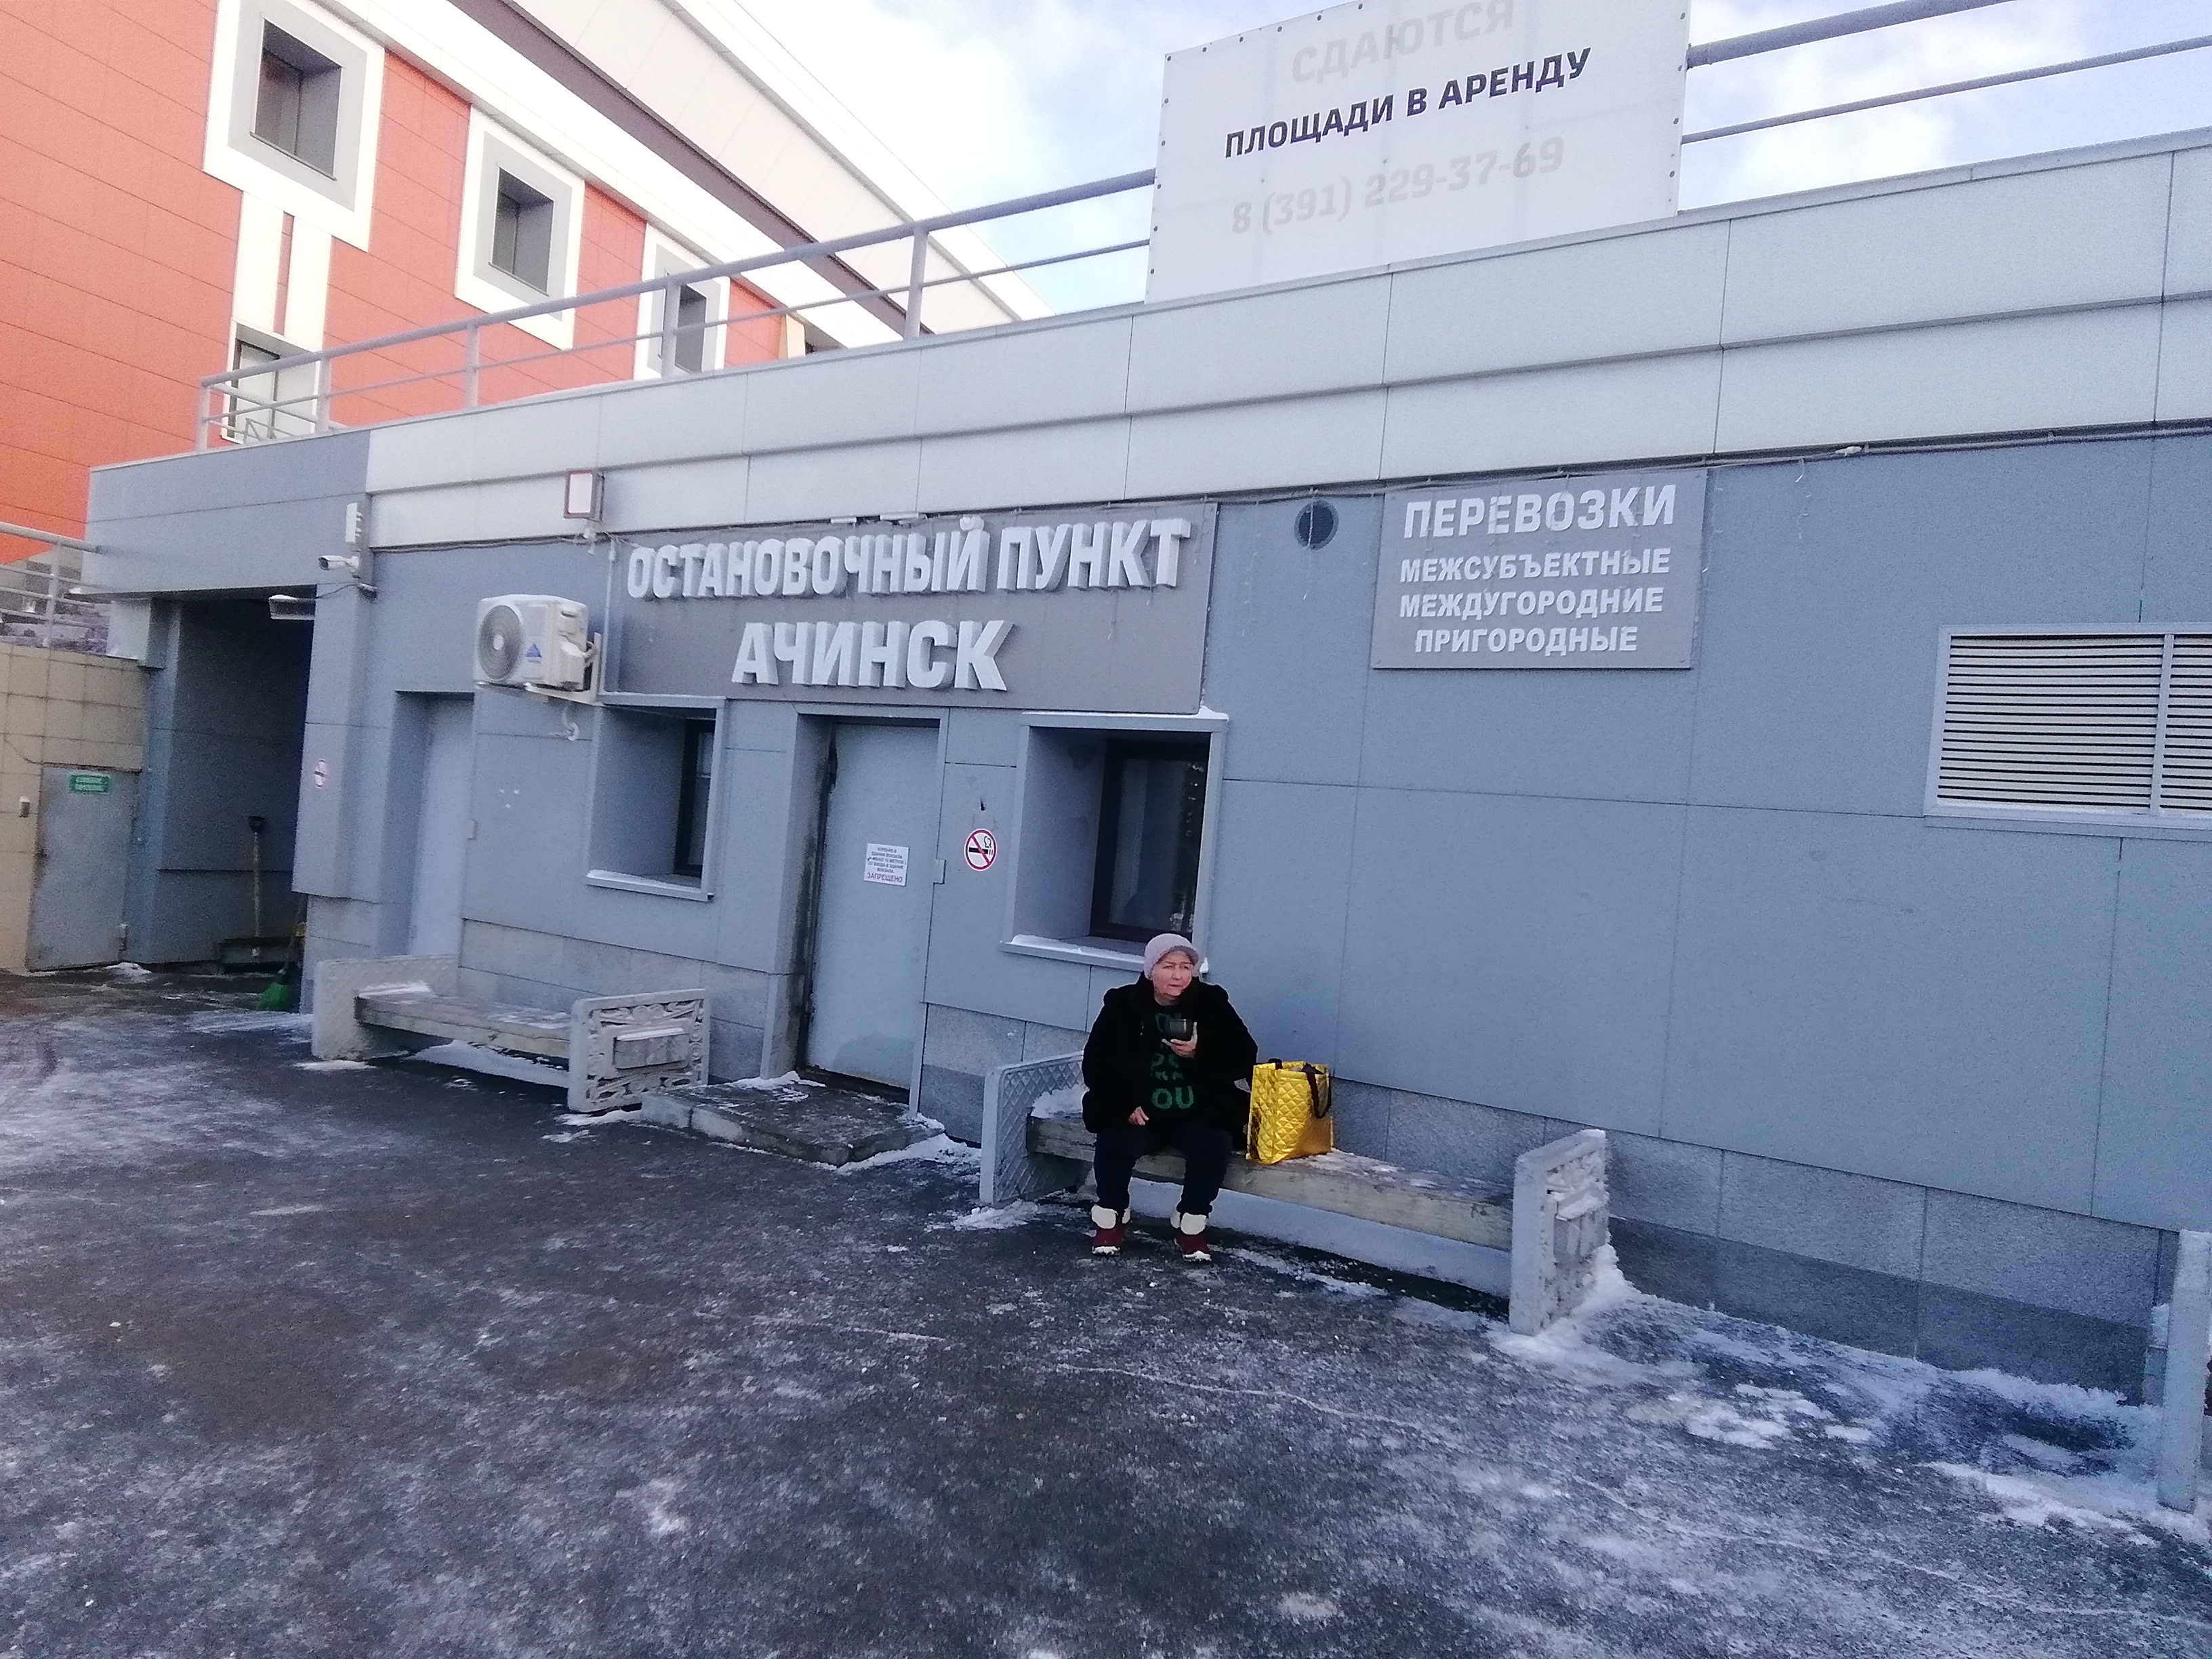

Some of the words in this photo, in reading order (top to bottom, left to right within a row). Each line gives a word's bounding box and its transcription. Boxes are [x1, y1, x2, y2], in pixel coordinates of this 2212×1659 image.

[1292, 0, 1514, 84] СДАЮТСЯ
[1225, 94, 1394, 159] ПЛОЩАДИ
[1406, 87, 1428, 117] В
[1438, 47, 1591, 110] АРЕНДУ
[1232, 201, 1252, 234] 8
[1263, 176, 1353, 236] (391)
[1364, 136, 1565, 209] 229-37-69
[1404, 485, 1677, 539] ПЕРЕВОЗКИ
[627, 515, 990, 599] ОСТАНОВОЧНЫЙ
[997, 518, 1191, 592] ПУНКТ
[1400, 548, 1671, 583] МЕЖСУБЪЕКТНЫЕ
[1399, 587, 1664, 621] МЕЖДУГОРОДНИЕ
[731, 619, 1014, 692] АЧИНСК
[1415, 626, 1638, 657] ПРИГОРОДНЫЕ
[867, 872, 903, 883] ЗАПРЕЩЕНО
